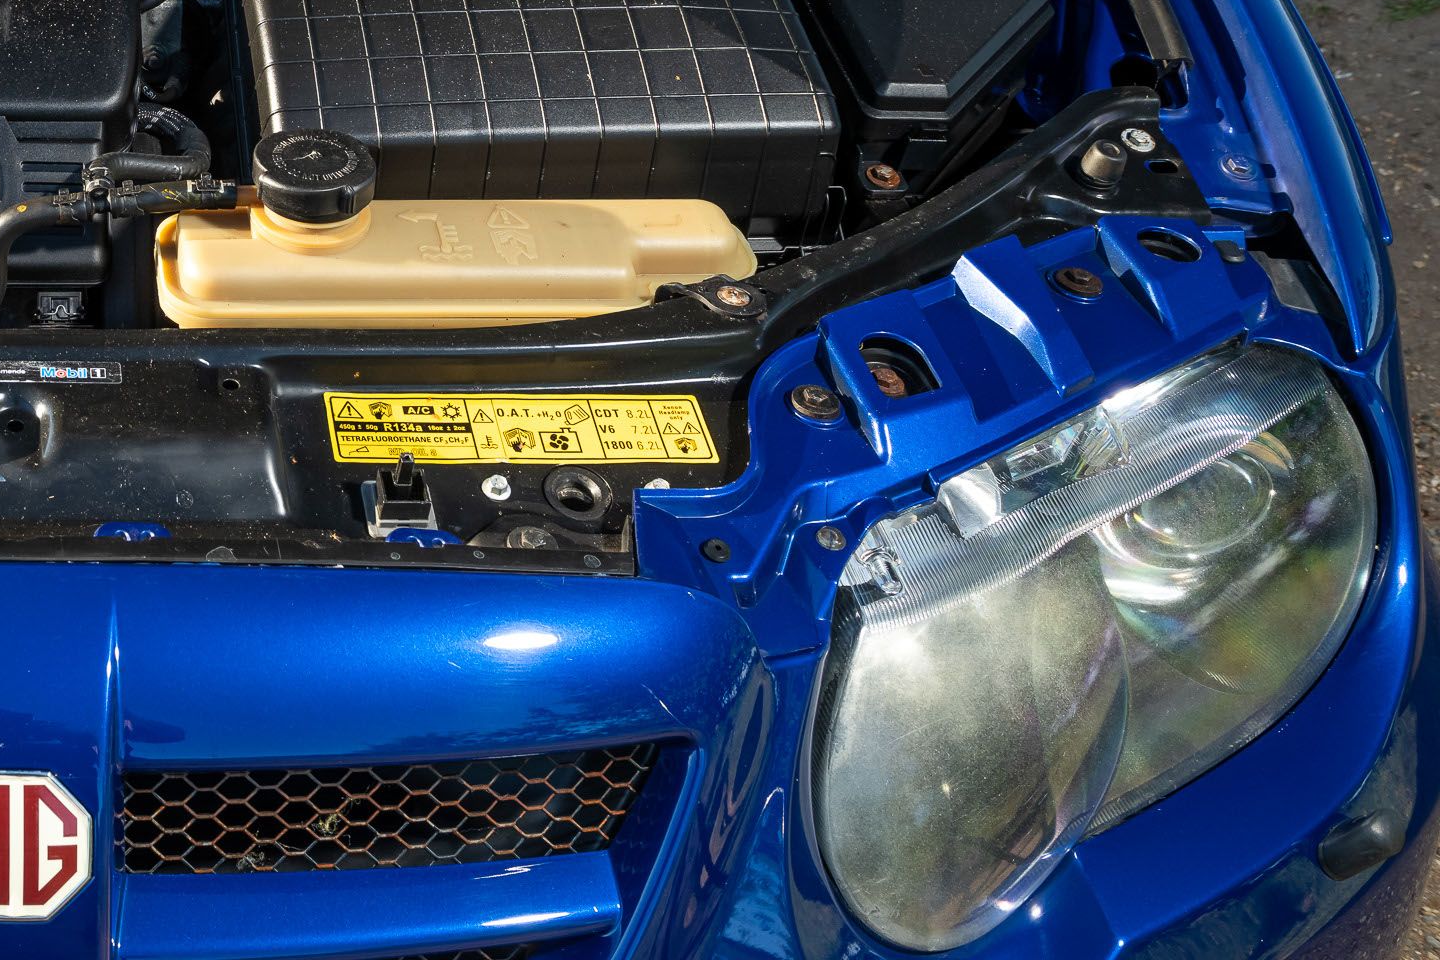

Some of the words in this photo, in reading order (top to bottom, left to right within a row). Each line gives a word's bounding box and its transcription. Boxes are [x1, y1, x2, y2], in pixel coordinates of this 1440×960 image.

[40, 367, 87, 378] Mobil
[407, 406, 431, 415] A/C
[496, 408, 534, 418] O.A.T.
[594, 408, 619, 418] CDT
[625, 409, 652, 419] 8.2L
[383, 422, 423, 432] R134a
[598, 424, 616, 434] V6
[631, 425, 657, 435] 7.2L
[340, 435, 432, 443] TETRAFLUOROETHANE
[603, 440, 634, 450] 1800
[636, 441, 663, 451] 6.2L
